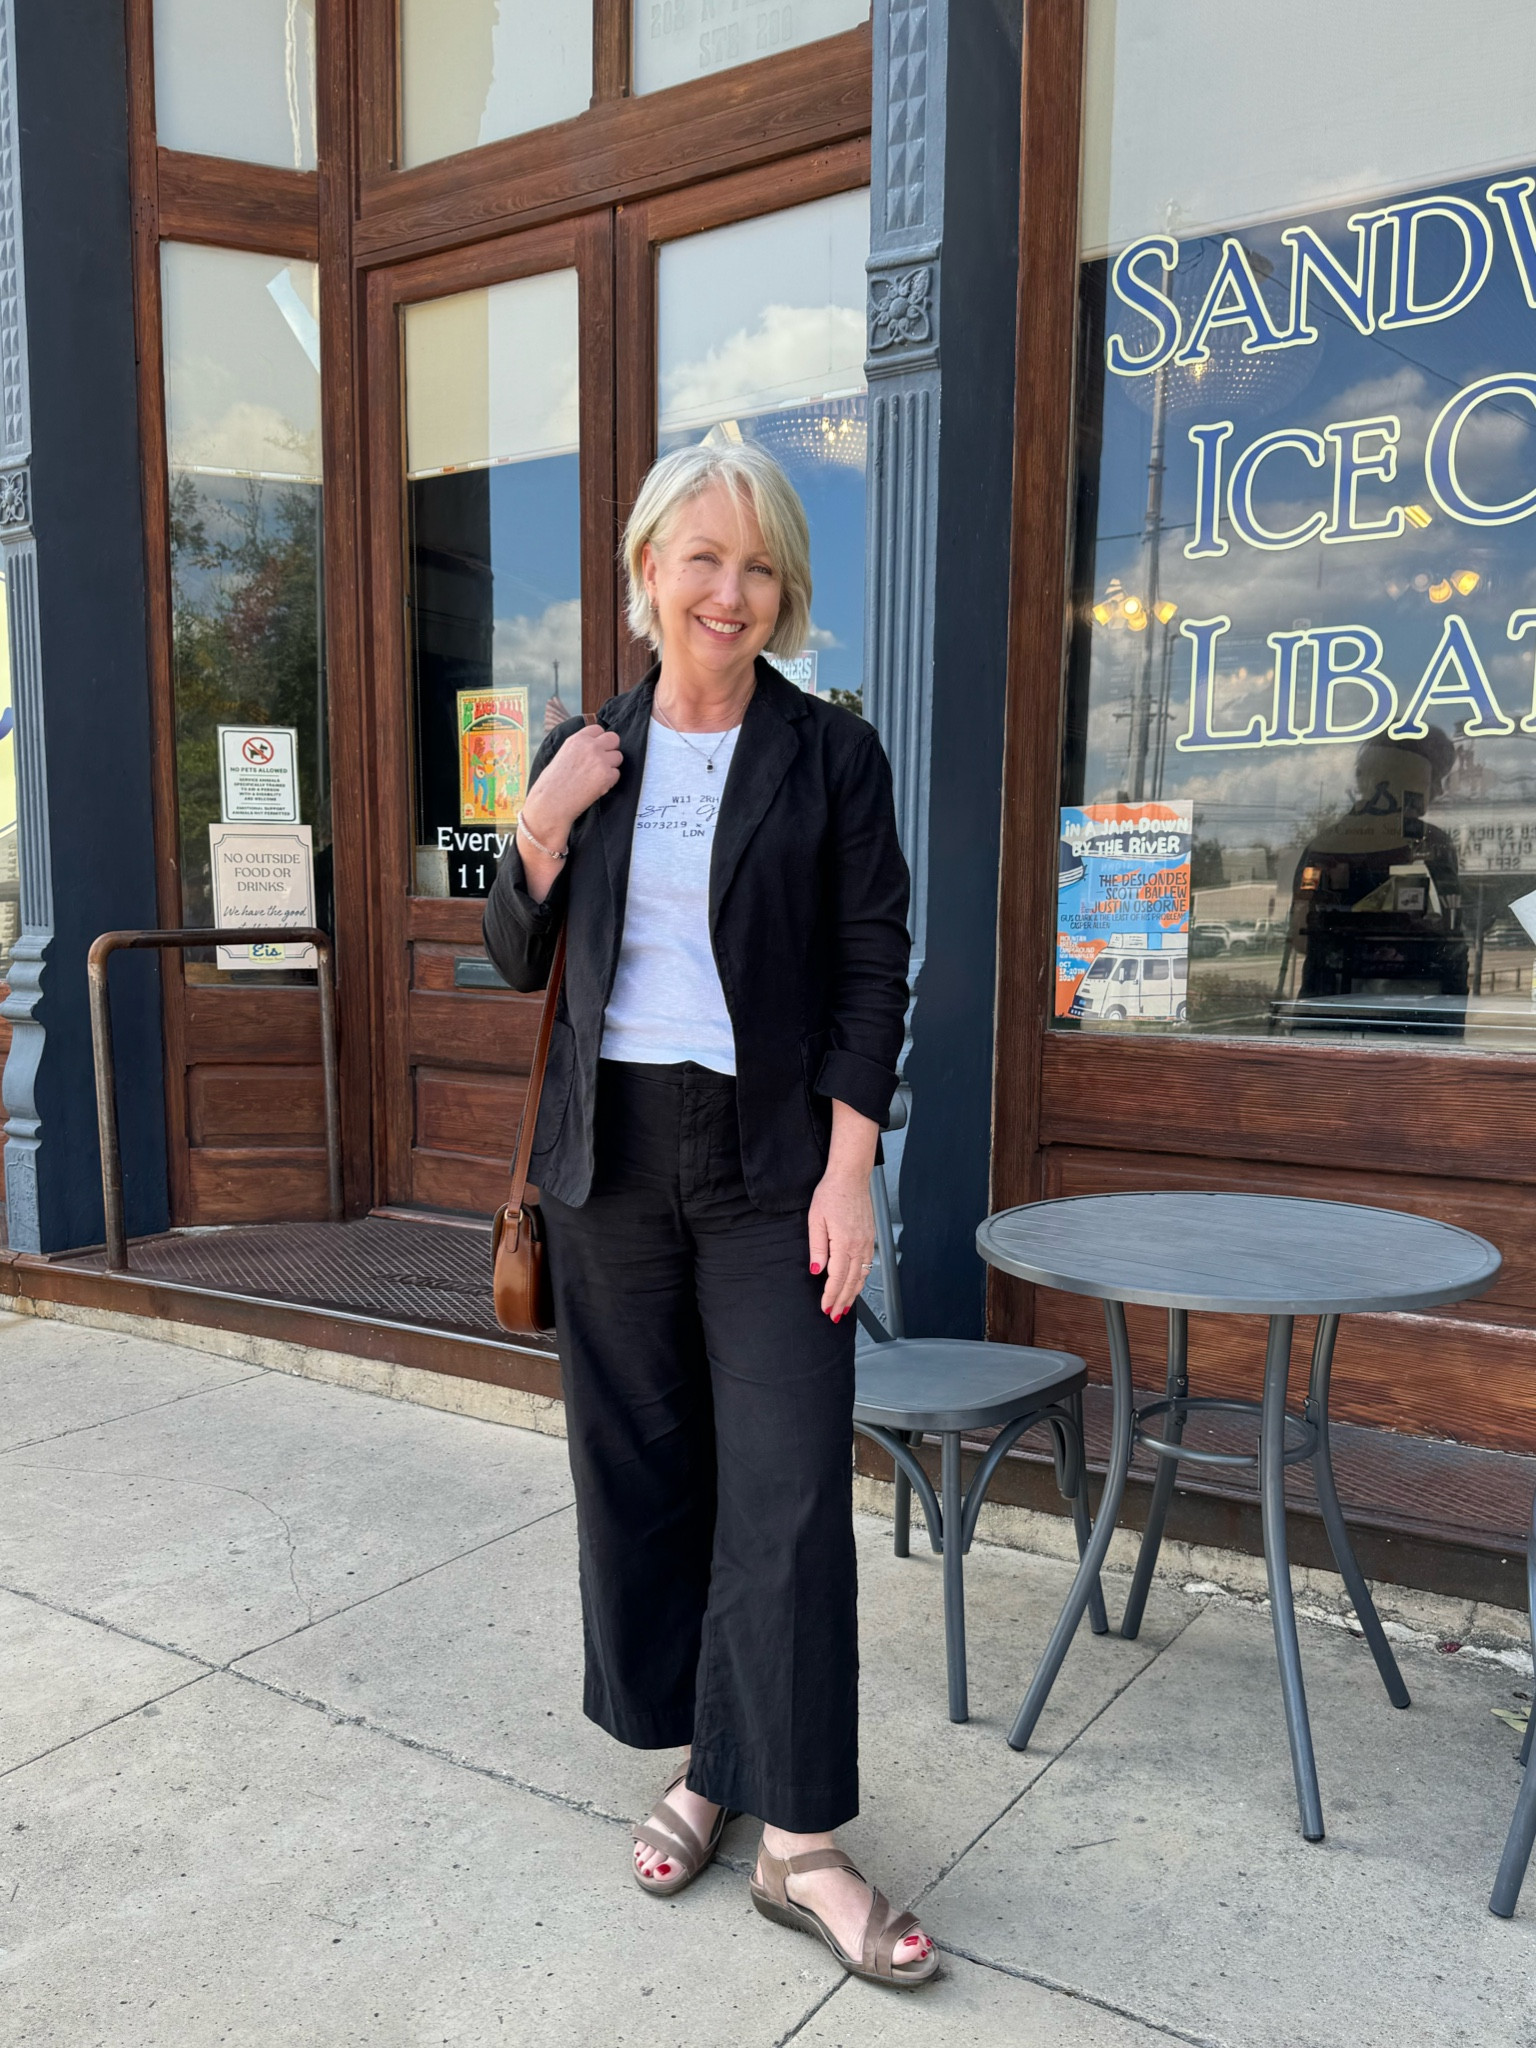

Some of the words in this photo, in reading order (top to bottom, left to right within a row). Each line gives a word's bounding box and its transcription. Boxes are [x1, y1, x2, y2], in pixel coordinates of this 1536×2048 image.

[1184, 415, 1404, 560] ICE
[682, 829, 706, 838] LDN
[1085, 821, 1096, 836] A
[1101, 818, 1134, 836] JAM
[1138, 817, 1189, 834] DOWN
[437, 826, 515, 859] Every
[1072, 840, 1091, 857] BY
[1096, 838, 1124, 855] THE
[223, 853, 243, 864] NO
[246, 853, 301, 864] OUTSIDE
[234, 867, 271, 878] FOOD
[272, 867, 291, 878] OR
[458, 863, 486, 889] 11
[1099, 874, 1121, 888] THE
[1122, 872, 1188, 887] DESLONDES
[237, 881, 288, 892] DRINKS.
[1105, 887, 1140, 901] SCOTT
[1145, 886, 1188, 900] BALLEW
[223, 905, 240, 917] We
[241, 905, 265, 917] have
[266, 905, 283, 917] the
[281, 906, 307, 922] good
[1092, 900, 1131, 915] JUSTIN
[1134, 899, 1187, 913] OSBORNE
[253, 943, 282, 957] Eis
